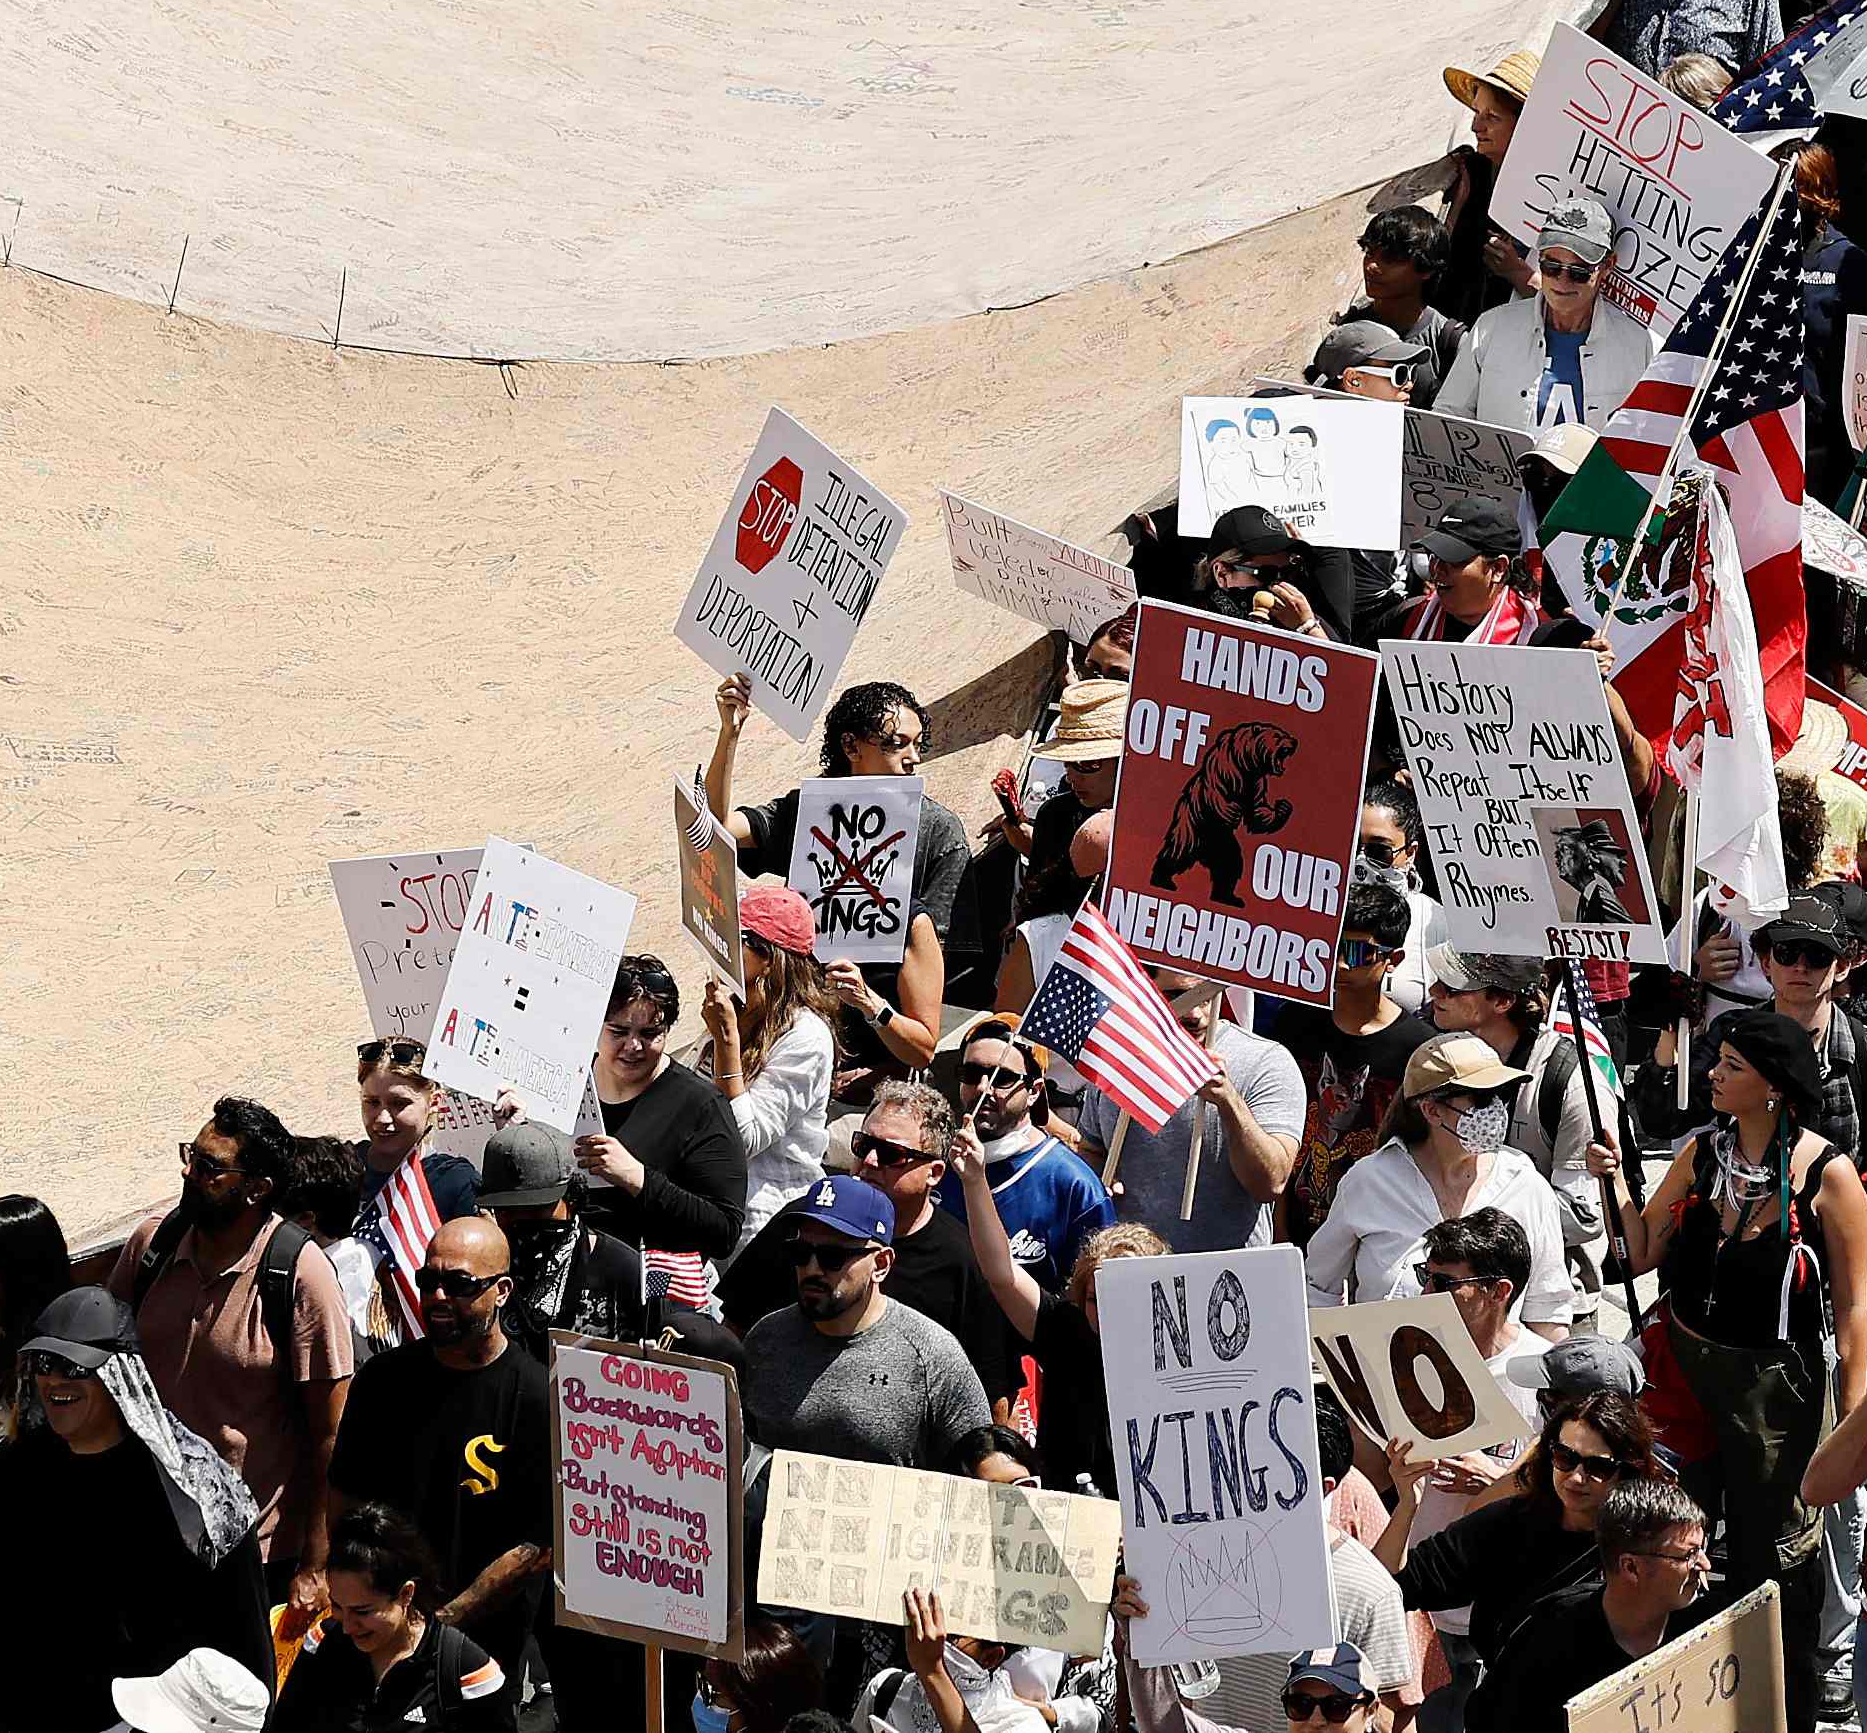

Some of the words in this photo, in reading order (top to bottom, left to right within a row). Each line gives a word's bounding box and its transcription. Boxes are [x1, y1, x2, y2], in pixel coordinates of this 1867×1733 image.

[1568, 57, 1706, 181] STOP
[1568, 129, 1722, 265] HITTING
[737, 476, 798, 550] STOP
[813, 469, 891, 566] ILLEGAL
[786, 521, 878, 629] DETENTION
[693, 573, 825, 717] DEPORTATION
[1179, 626, 1330, 714] HANDS
[1394, 653, 1515, 731] History
[1127, 696, 1213, 767] OFF
[1467, 722, 1515, 758] NOT
[1528, 721, 1618, 767] ALWAYS
[831, 802, 887, 841] NO
[1474, 823, 1540, 863] Often
[1251, 842, 1342, 919] OUR
[1446, 864, 1535, 931] Rhymes.
[1106, 884, 1333, 996] NEIGHBORS
[1545, 925, 1632, 964] RESIST!
[1148, 1267, 1253, 1374] NO
[600, 1353, 690, 1403] GOING
[1124, 1385, 1311, 1529] KINGS
[594, 1541, 706, 1598] ENOUGH
